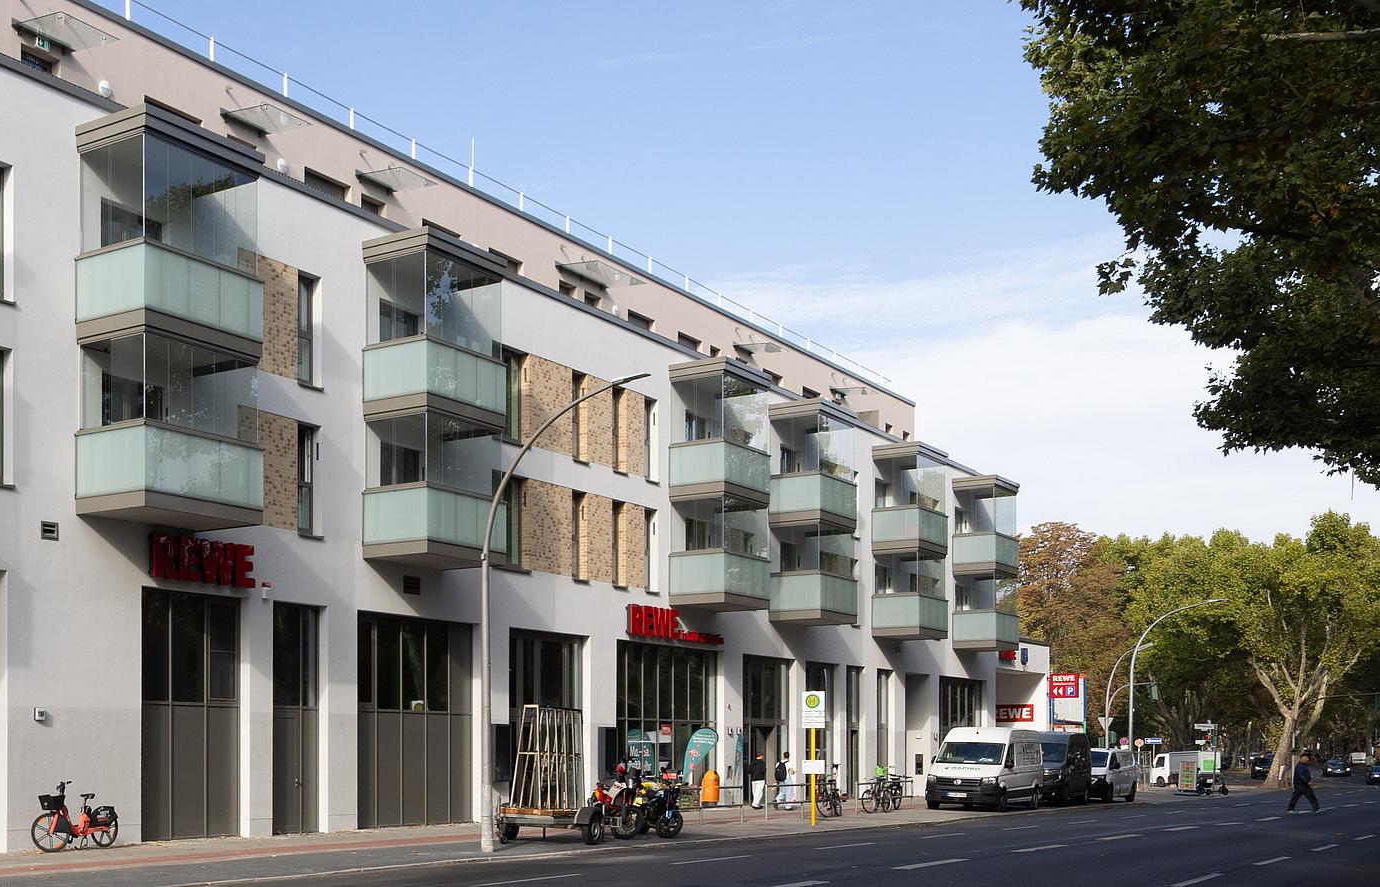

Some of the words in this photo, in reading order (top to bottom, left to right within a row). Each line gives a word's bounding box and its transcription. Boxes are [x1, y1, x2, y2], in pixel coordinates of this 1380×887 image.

[150, 533, 256, 588] REWE
[627, 604, 680, 640] REWE
[996, 707, 1032, 719] EWE
